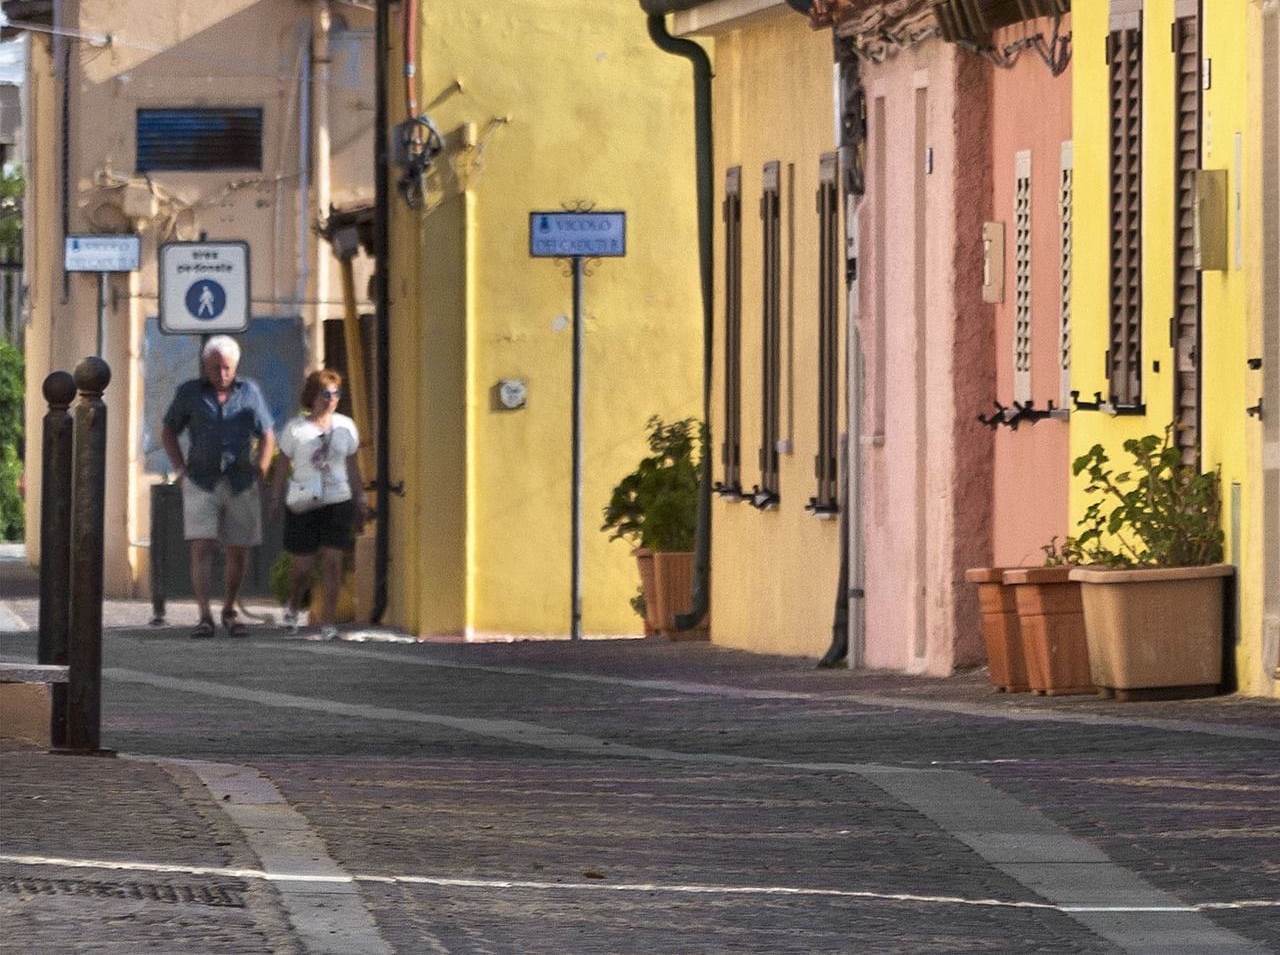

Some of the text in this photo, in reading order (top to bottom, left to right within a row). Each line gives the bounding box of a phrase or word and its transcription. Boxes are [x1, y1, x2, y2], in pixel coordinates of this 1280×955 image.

[556, 220, 612, 232] VICOLO
[192, 251, 219, 260] area
[176, 263, 234, 274] pedonale
